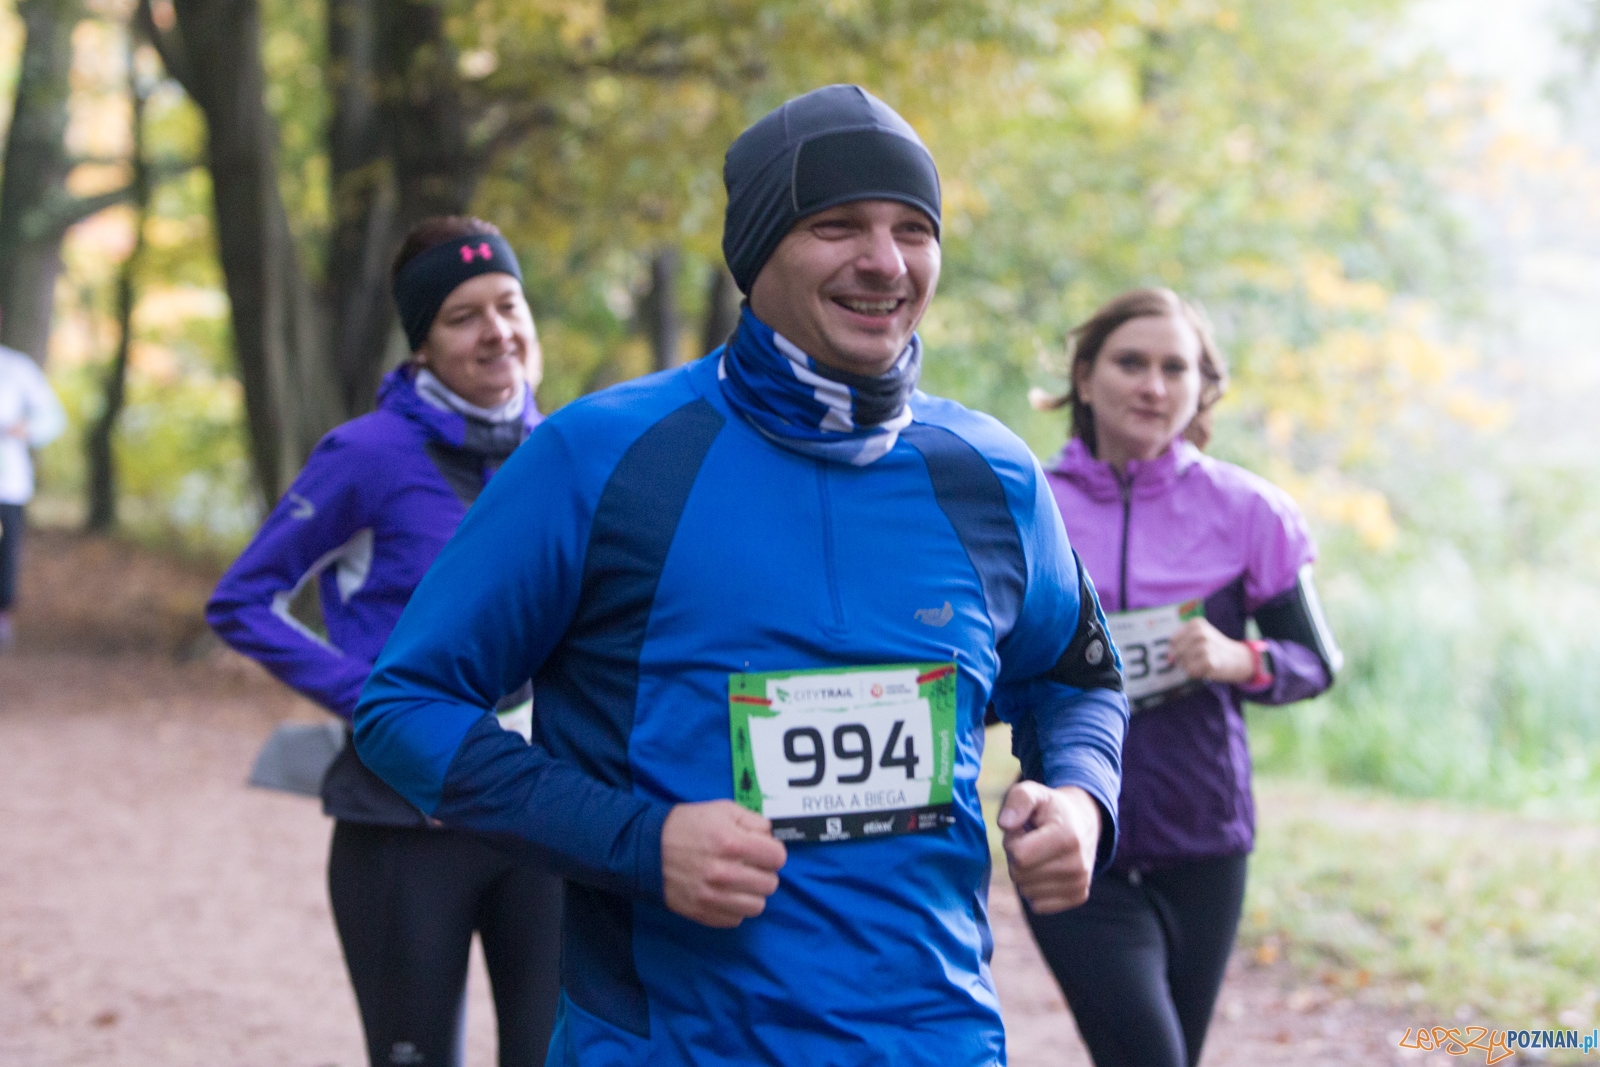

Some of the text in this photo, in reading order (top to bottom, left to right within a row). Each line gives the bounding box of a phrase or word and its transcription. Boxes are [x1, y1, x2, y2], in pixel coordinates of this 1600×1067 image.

[783, 720, 919, 788] 994
[801, 789, 907, 811] RYBA A BIEGA
